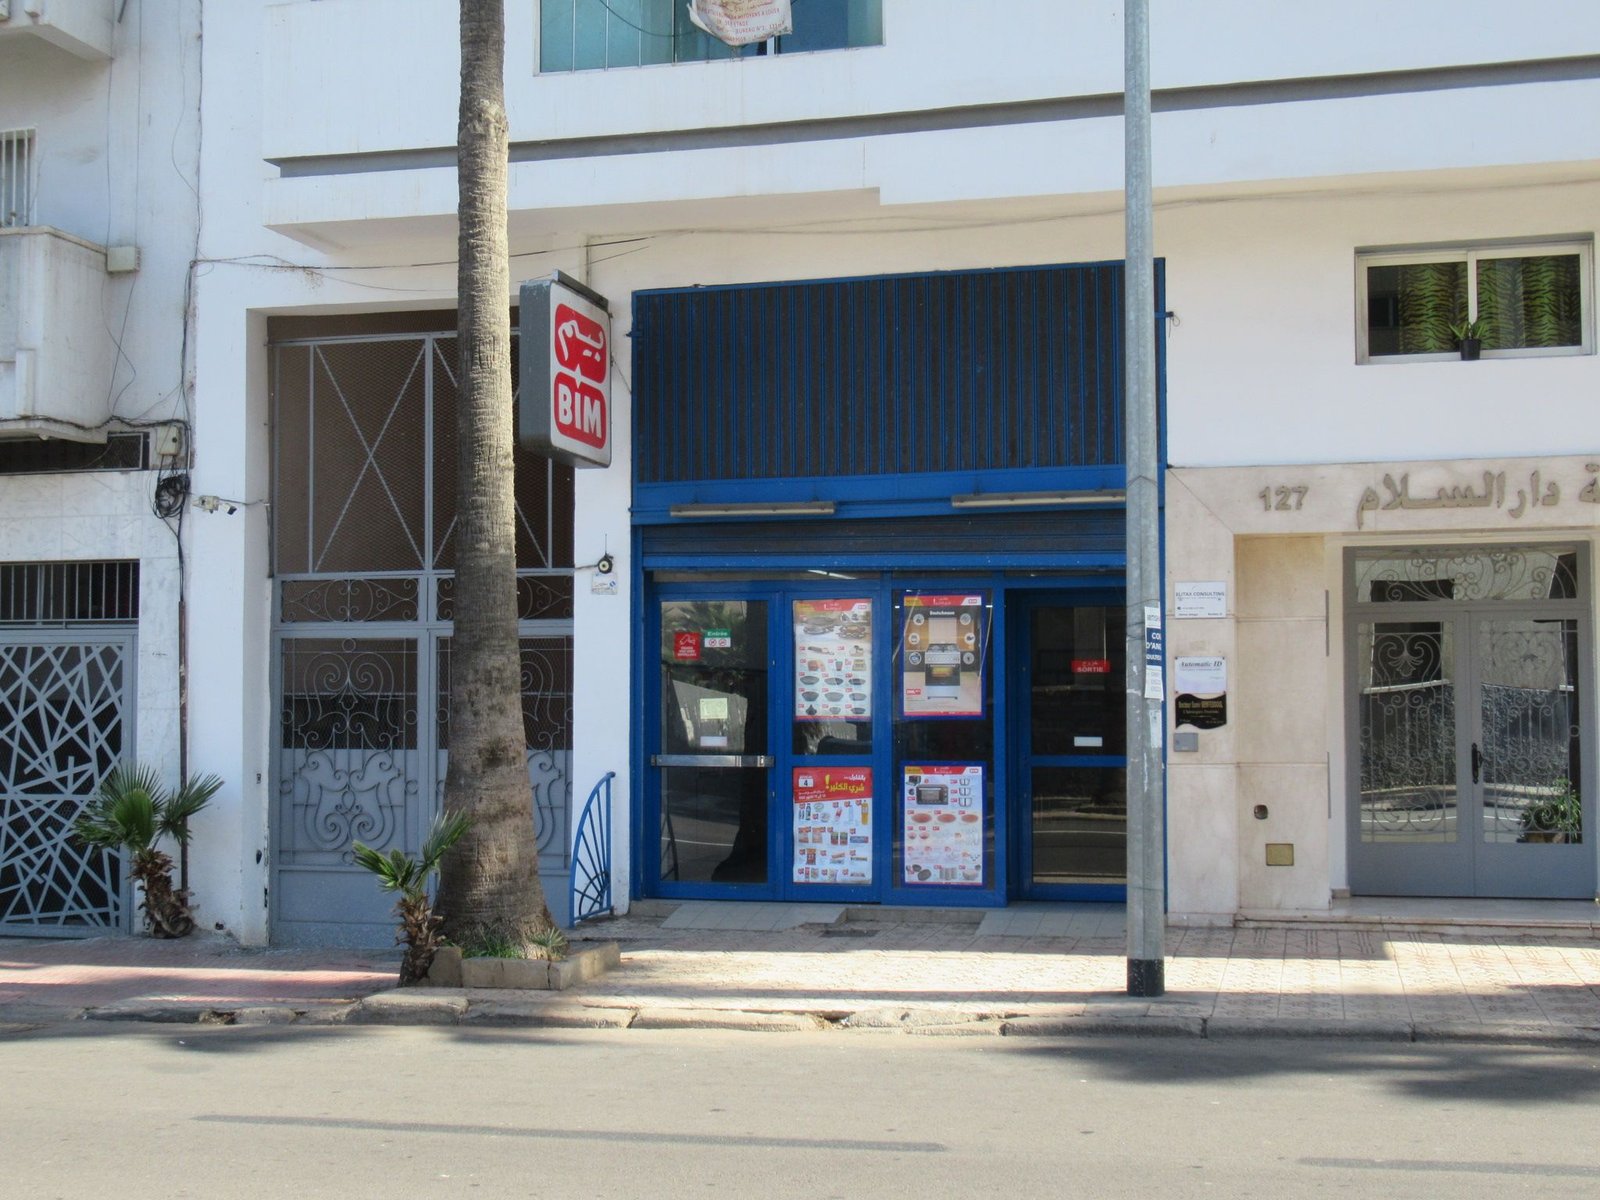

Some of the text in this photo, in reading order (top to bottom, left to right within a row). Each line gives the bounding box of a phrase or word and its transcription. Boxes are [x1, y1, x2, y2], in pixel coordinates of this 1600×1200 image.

[558, 319, 605, 362] بيم
[558, 383, 602, 439] BIM
[1258, 485, 1309, 511] 127
[1357, 470, 1506, 531] السلام
